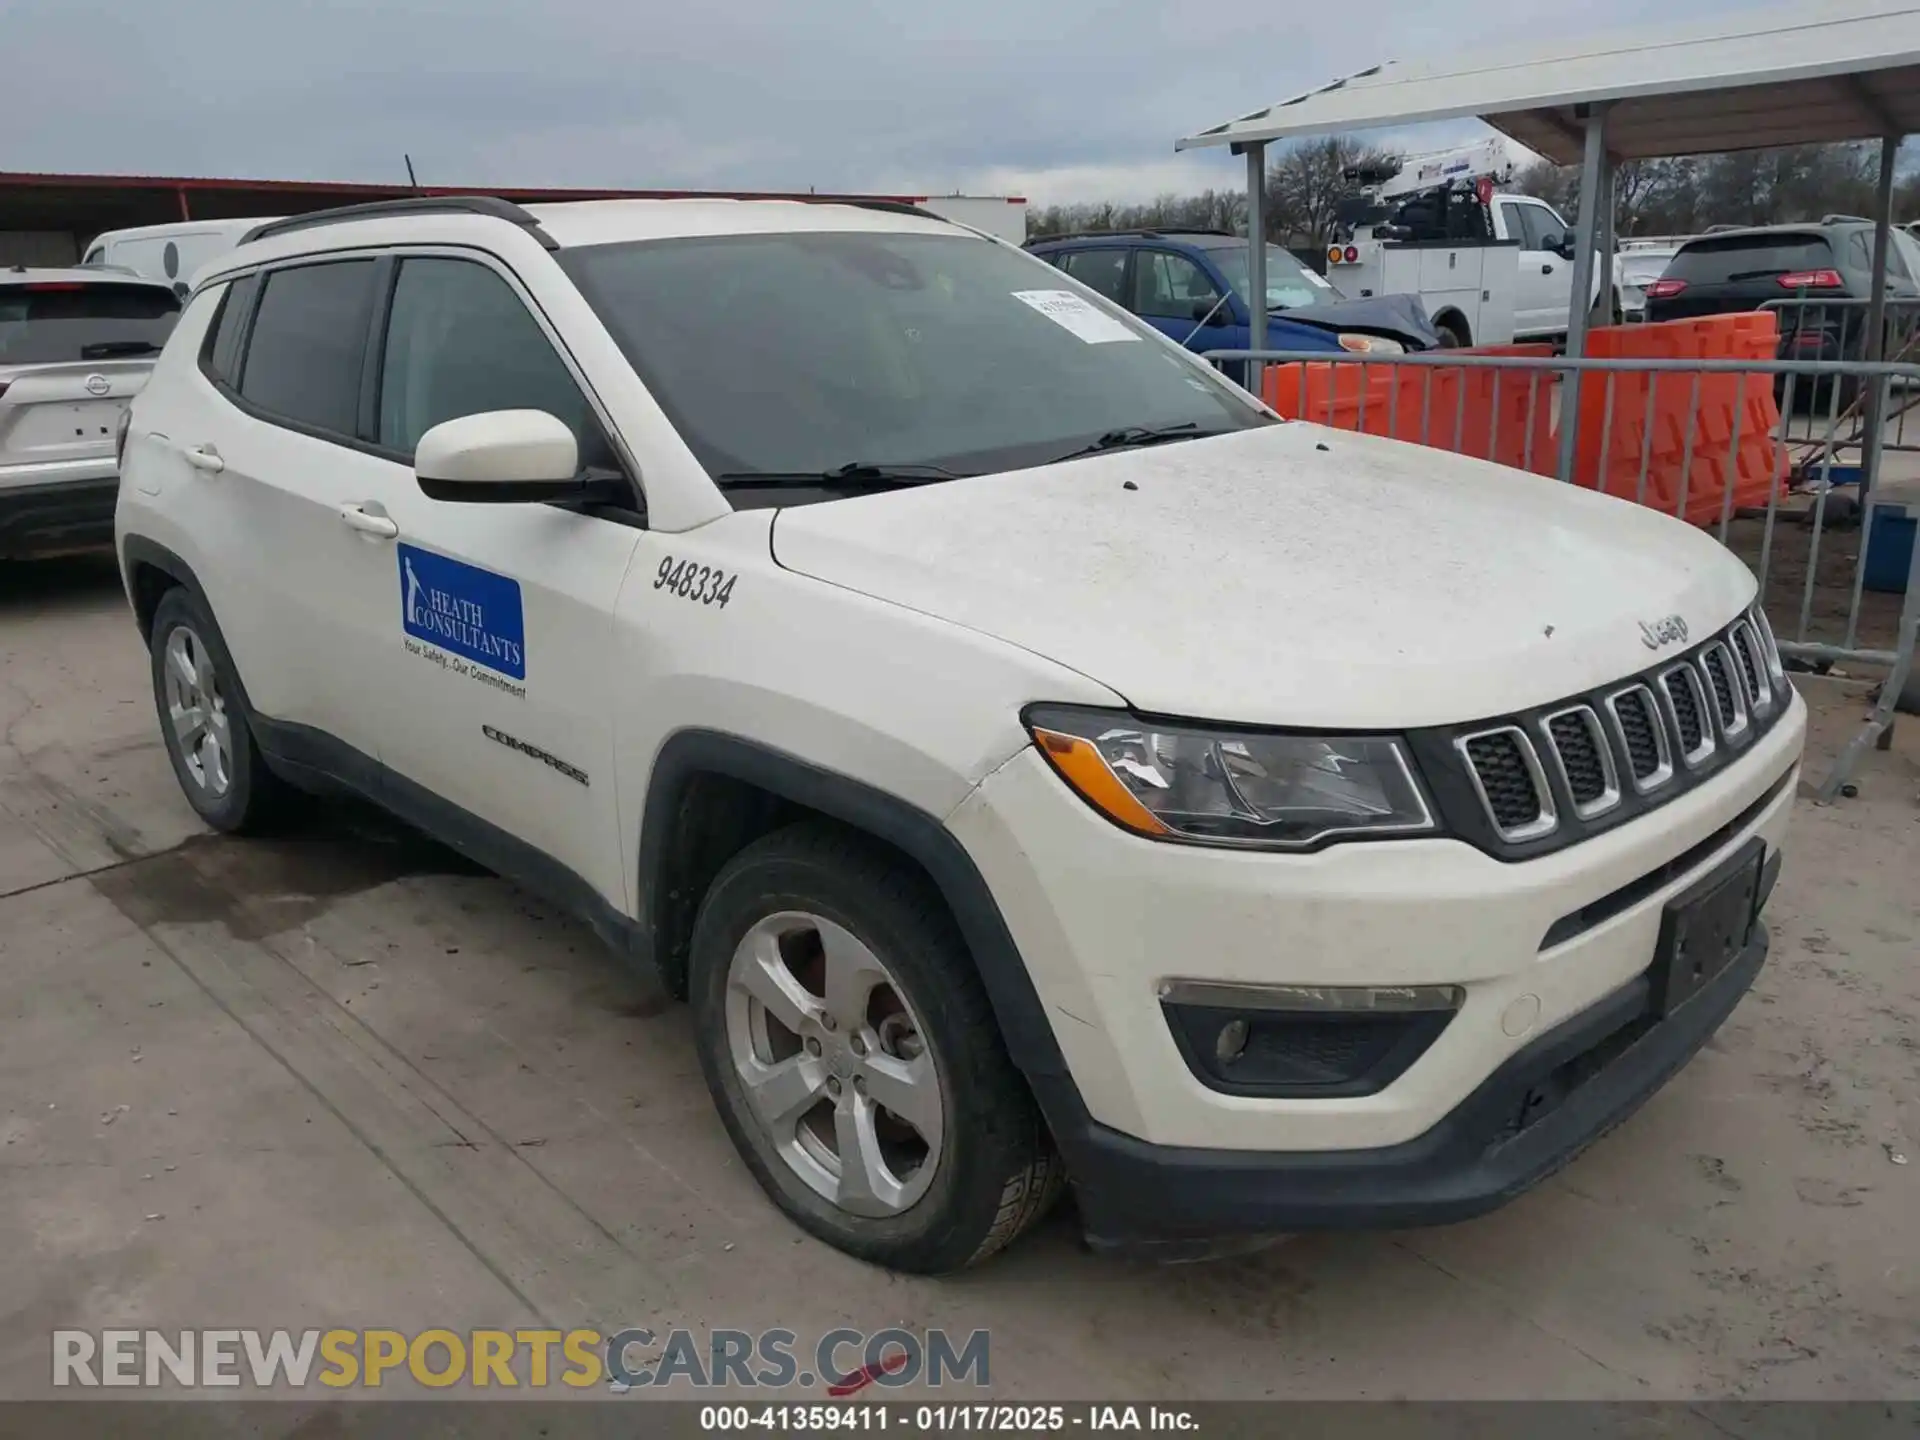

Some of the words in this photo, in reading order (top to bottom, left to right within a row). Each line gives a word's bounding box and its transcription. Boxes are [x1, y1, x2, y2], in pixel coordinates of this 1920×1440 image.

[430, 587, 483, 628] HEATH
[653, 555, 738, 609] 948334
[415, 605, 521, 666] CONSULTANTS
[1637, 614, 1688, 650] Jeep
[403, 638, 421, 655] Your
[470, 664, 526, 700] Commitment
[482, 724, 590, 787] COMPASS
